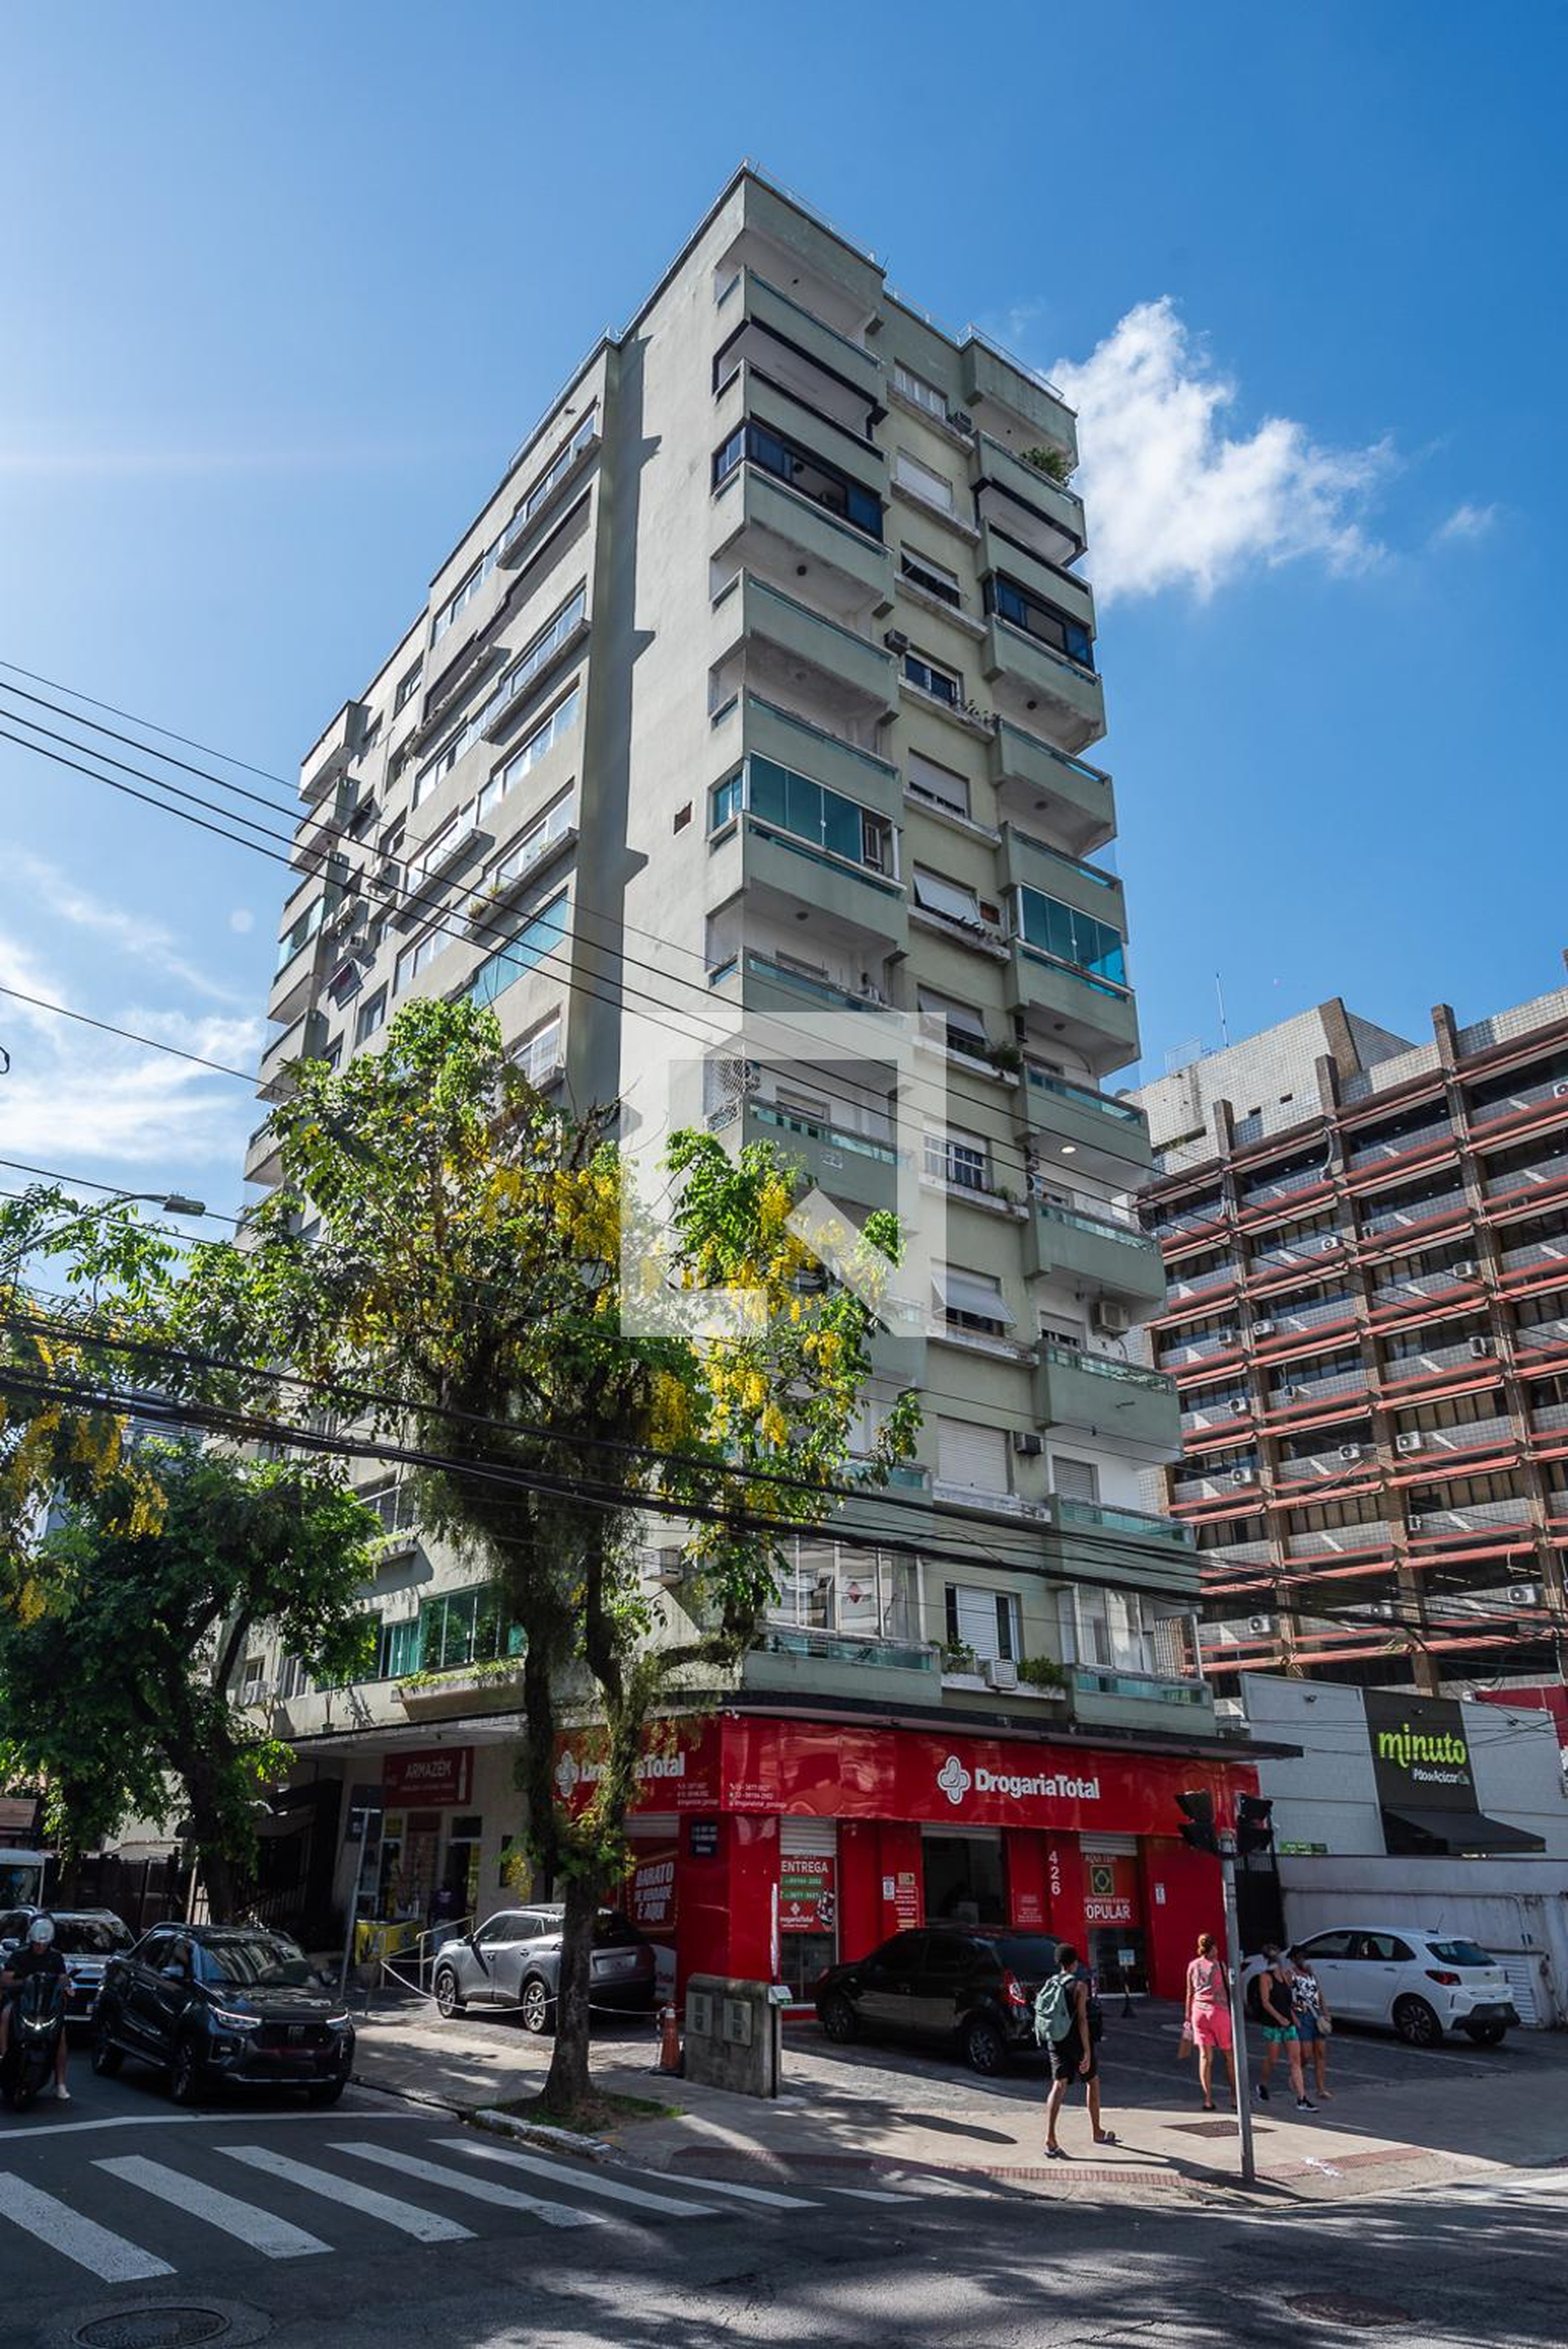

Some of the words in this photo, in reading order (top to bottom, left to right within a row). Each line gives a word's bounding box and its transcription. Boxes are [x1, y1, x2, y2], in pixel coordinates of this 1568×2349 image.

[1378, 1723, 1466, 1768] minuto
[975, 1768, 1100, 1799] DrogariaTotal
[781, 1860, 829, 1873] ENTREGA
[1049, 1850, 1061, 1895] 426
[1084, 1904, 1131, 1919] OPULAR
